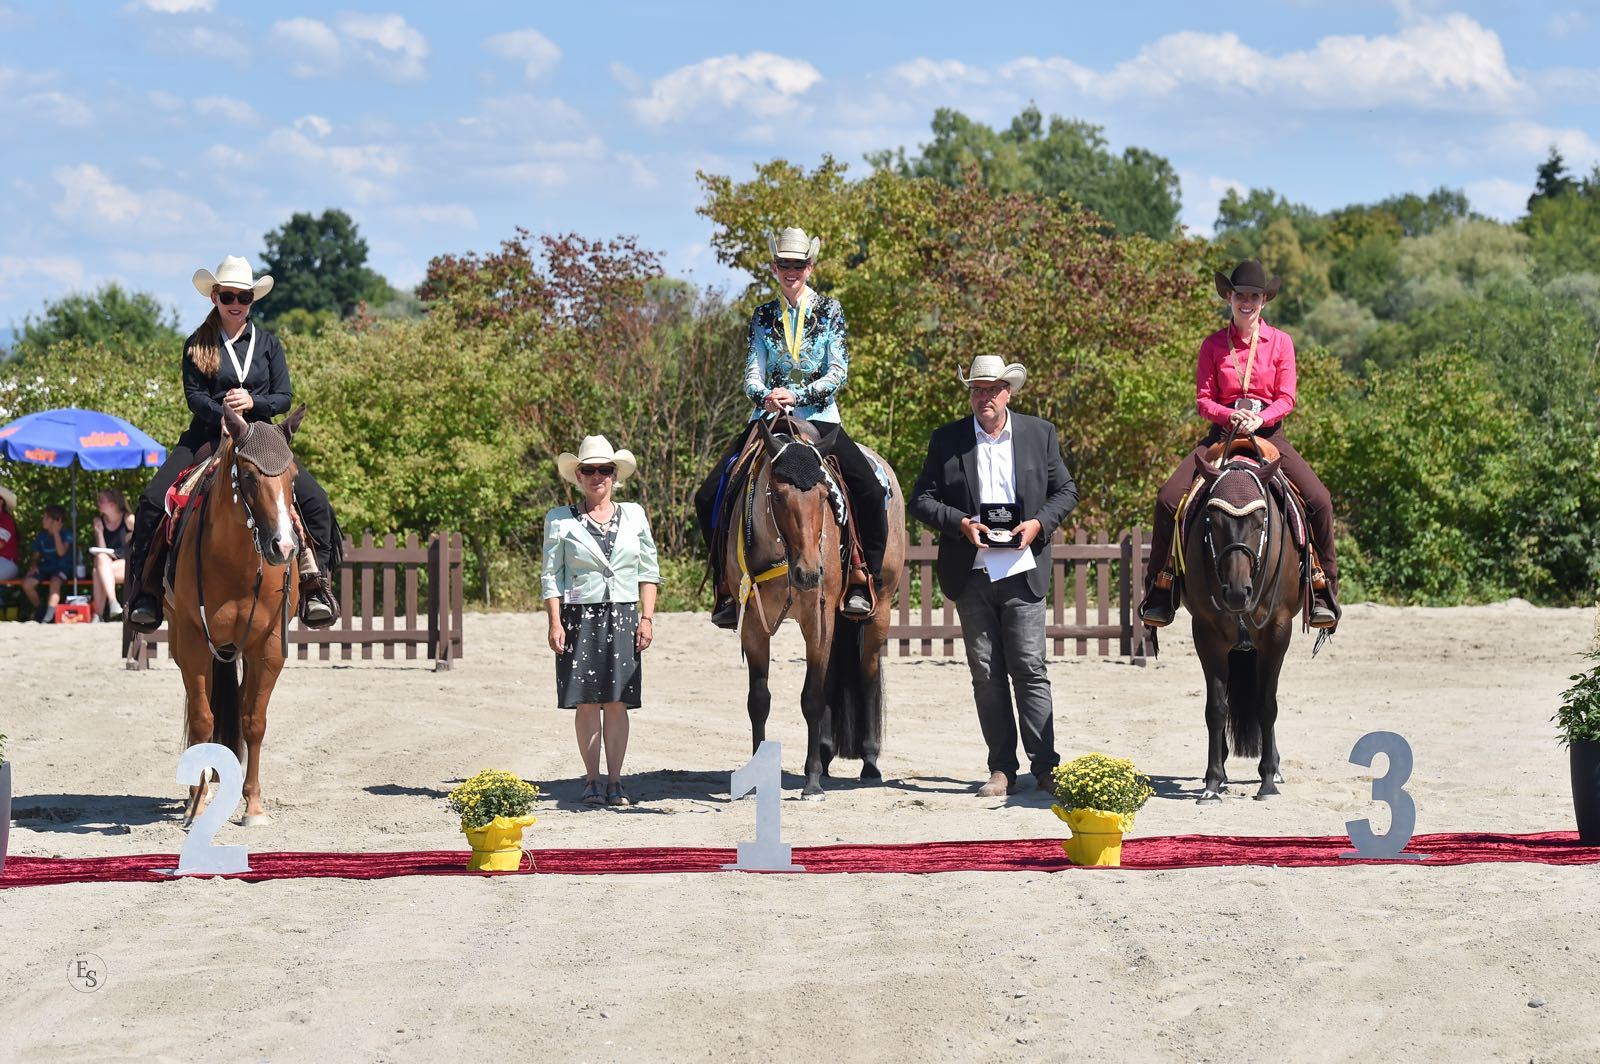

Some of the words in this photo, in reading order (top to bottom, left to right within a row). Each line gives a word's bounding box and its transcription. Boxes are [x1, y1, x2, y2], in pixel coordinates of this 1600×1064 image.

[175, 743, 249, 873] 2
[731, 741, 792, 869] 1
[1345, 731, 1416, 853] 3
